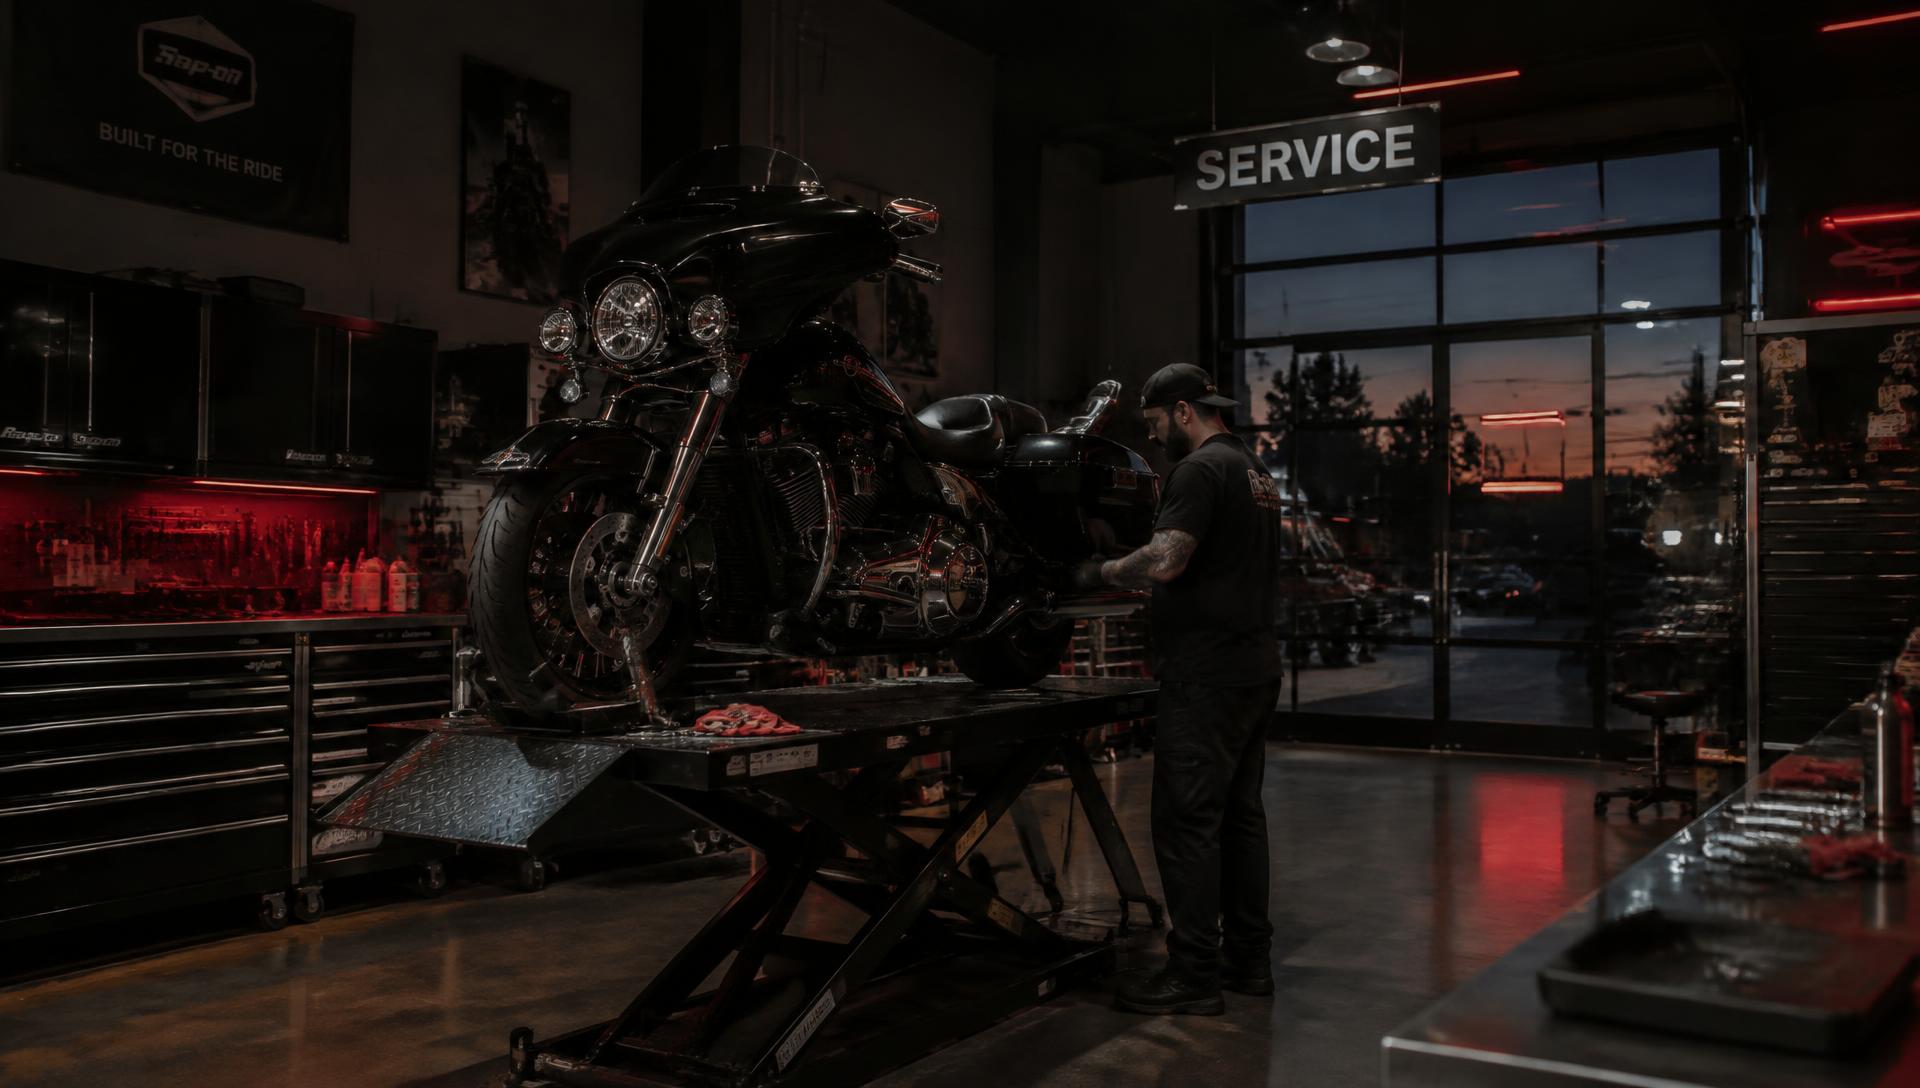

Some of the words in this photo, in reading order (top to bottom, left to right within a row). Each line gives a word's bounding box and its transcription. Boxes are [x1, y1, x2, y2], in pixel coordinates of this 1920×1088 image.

[99, 121, 157, 152] BUILT
[161, 138, 199, 163] FOR
[203, 148, 240, 173] THE
[243, 159, 284, 183] RIDE
[1196, 124, 1416, 191] SERVICE
